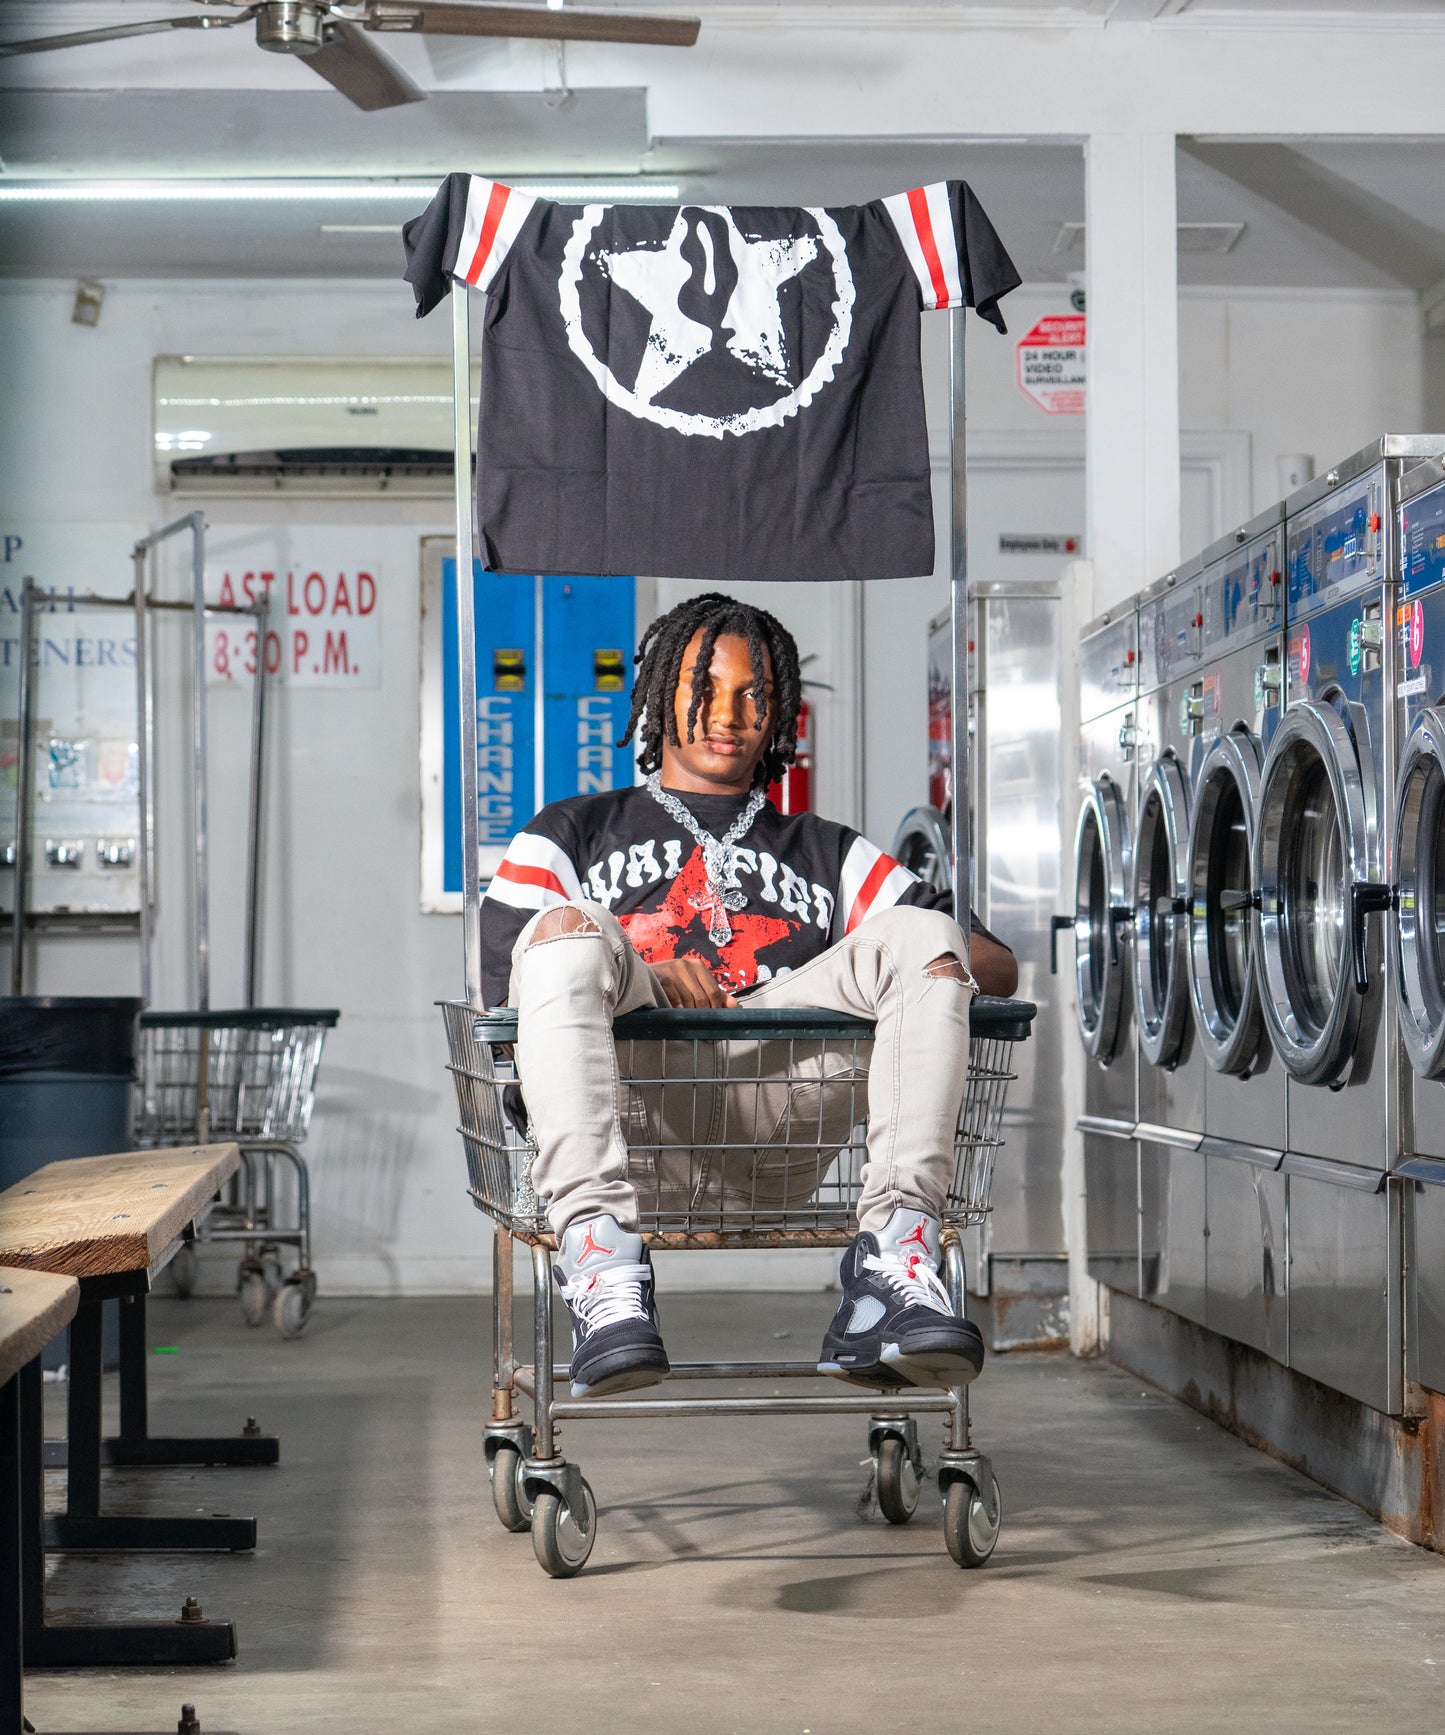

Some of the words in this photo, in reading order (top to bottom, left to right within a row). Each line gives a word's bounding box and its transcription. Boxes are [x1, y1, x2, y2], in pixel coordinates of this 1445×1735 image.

[1025, 363, 1063, 374] VIDEO
[1042, 351, 1077, 361] HOUR
[219, 571, 275, 615] AST
[287, 572, 378, 617] LOAD
[292, 630, 361, 675] P.M.
[1302, 636, 1309, 670] 5
[577, 696, 613, 793] CHAN
[478, 696, 513, 845] CHANGE
